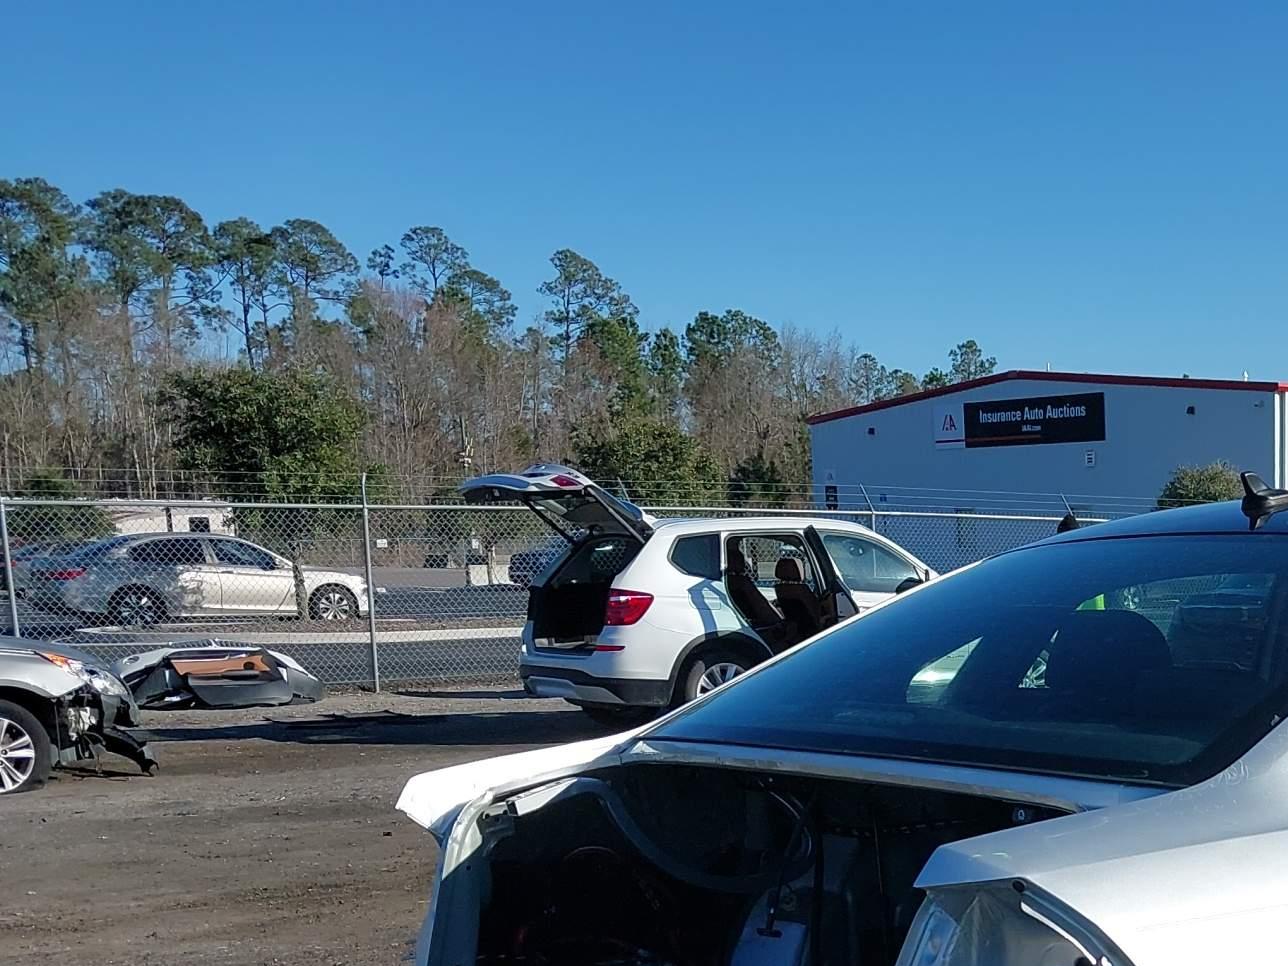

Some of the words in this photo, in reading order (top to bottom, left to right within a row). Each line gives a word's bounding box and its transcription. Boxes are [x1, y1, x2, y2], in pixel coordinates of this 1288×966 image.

[979, 408, 1022, 424] Insurance
[1023, 406, 1044, 421] Auto
[1046, 403, 1086, 419] Auctions
